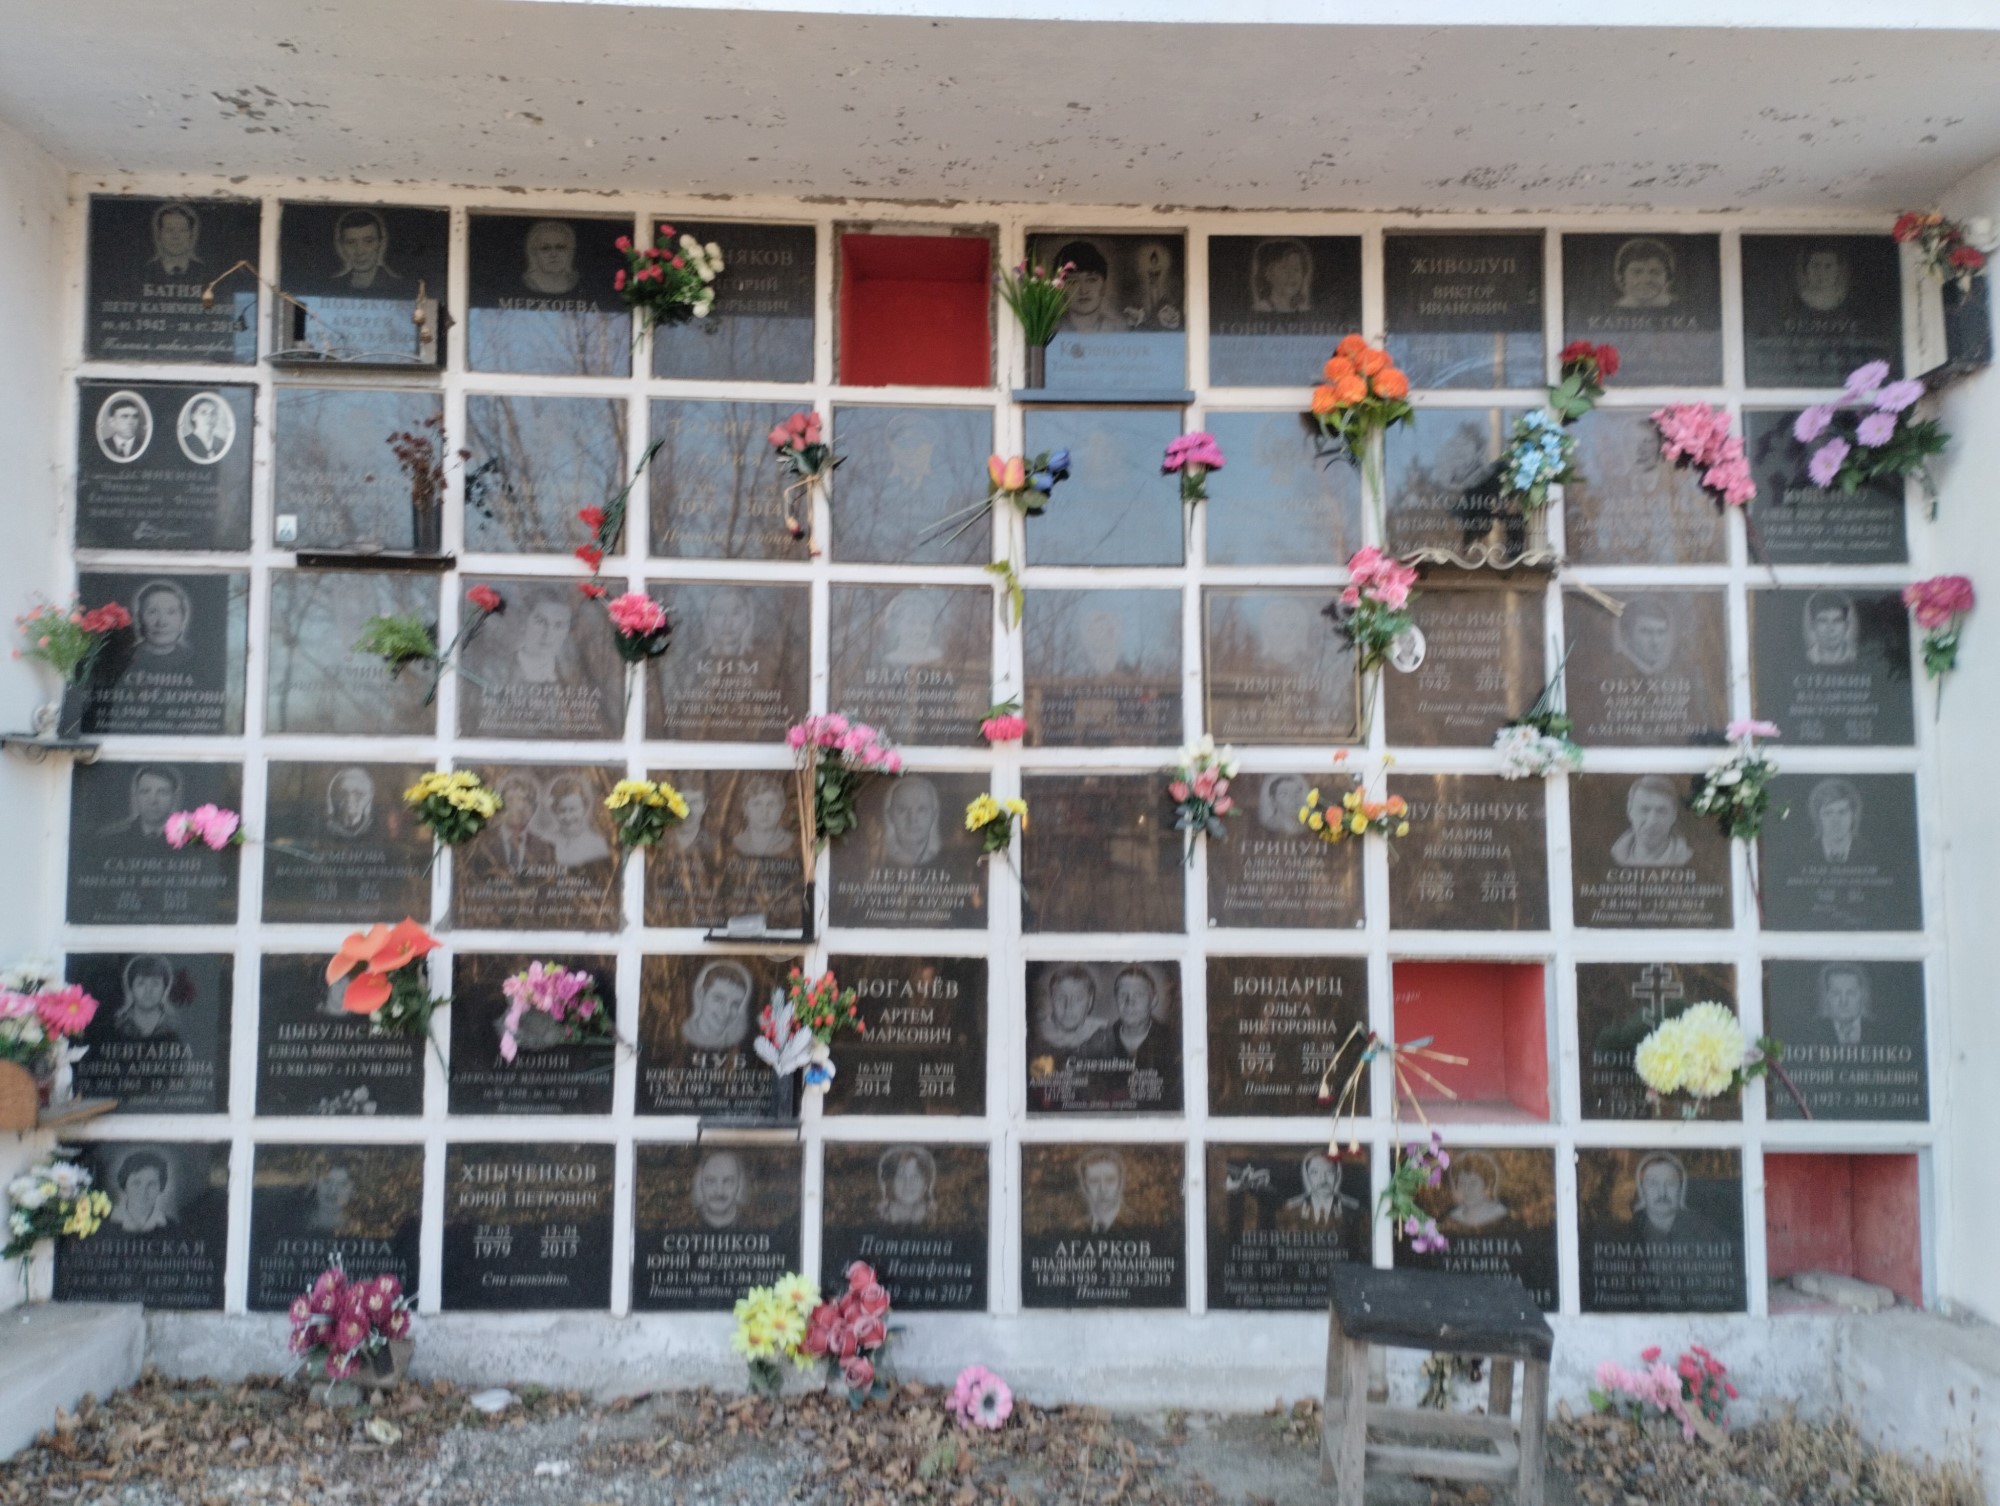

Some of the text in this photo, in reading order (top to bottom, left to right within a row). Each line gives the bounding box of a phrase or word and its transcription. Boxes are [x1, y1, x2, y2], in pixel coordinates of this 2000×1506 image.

[1411, 257, 1515, 274] ЖИВОЛУП
[143, 284, 203, 297] БАТНЯ
[1433, 286, 1495, 299] ВИКТОР
[697, 659, 759, 675] КИМ
[865, 667, 953, 685] ВЛАСОВА
[1406, 803, 1528, 821] ЛУКЬЯНЧУК
[1441, 827, 1493, 841] МАРИЯ
[1423, 844, 1512, 859] ЯКОВЛЕВНА
[1481, 886, 1517, 902] 2014
[857, 975, 959, 999] БОГАЧЁВ
[1233, 976, 1343, 998] БОНДАРЕЦ
[879, 1007, 934, 1024] АРТЕМ
[1263, 1001, 1311, 1017] ОЛЬГА
[278, 1023, 404, 1040] ЦЫБУЛЬСКАЯ
[861, 1026, 952, 1044] МАРКОВИЧ
[1238, 1018, 1338, 1035] ВИКТОРОВНА
[692, 1053, 747, 1069] ЧУБ
[1240, 1058, 1274, 1074] 1974
[854, 1080, 955, 1097] 2014 2014
[460, 1163, 597, 1184] ХНЫЧЕНКОВ
[459, 1189, 597, 1208] ЮРИЙ ПЕТРОВИЧ
[663, 1233, 770, 1252] СОТНИКОВ
[860, 1234, 953, 1256] Потанина
[1242, 1229, 1338, 1247] ШЕВЧЕНКО
[475, 1241, 512, 1259] 1979
[1055, 1240, 1151, 1257] АГАРКОВ
[1232, 1244, 1349, 1264] Павел Викторович
[647, 1252, 690, 1269] ЮРИЙ
[887, 1258, 972, 1280] Иосифовна
[1032, 1257, 1175, 1273] ВЛАДИМИР РОМАНОВИЧ
[1443, 1256, 1510, 1272] ТАТЬЯНА
